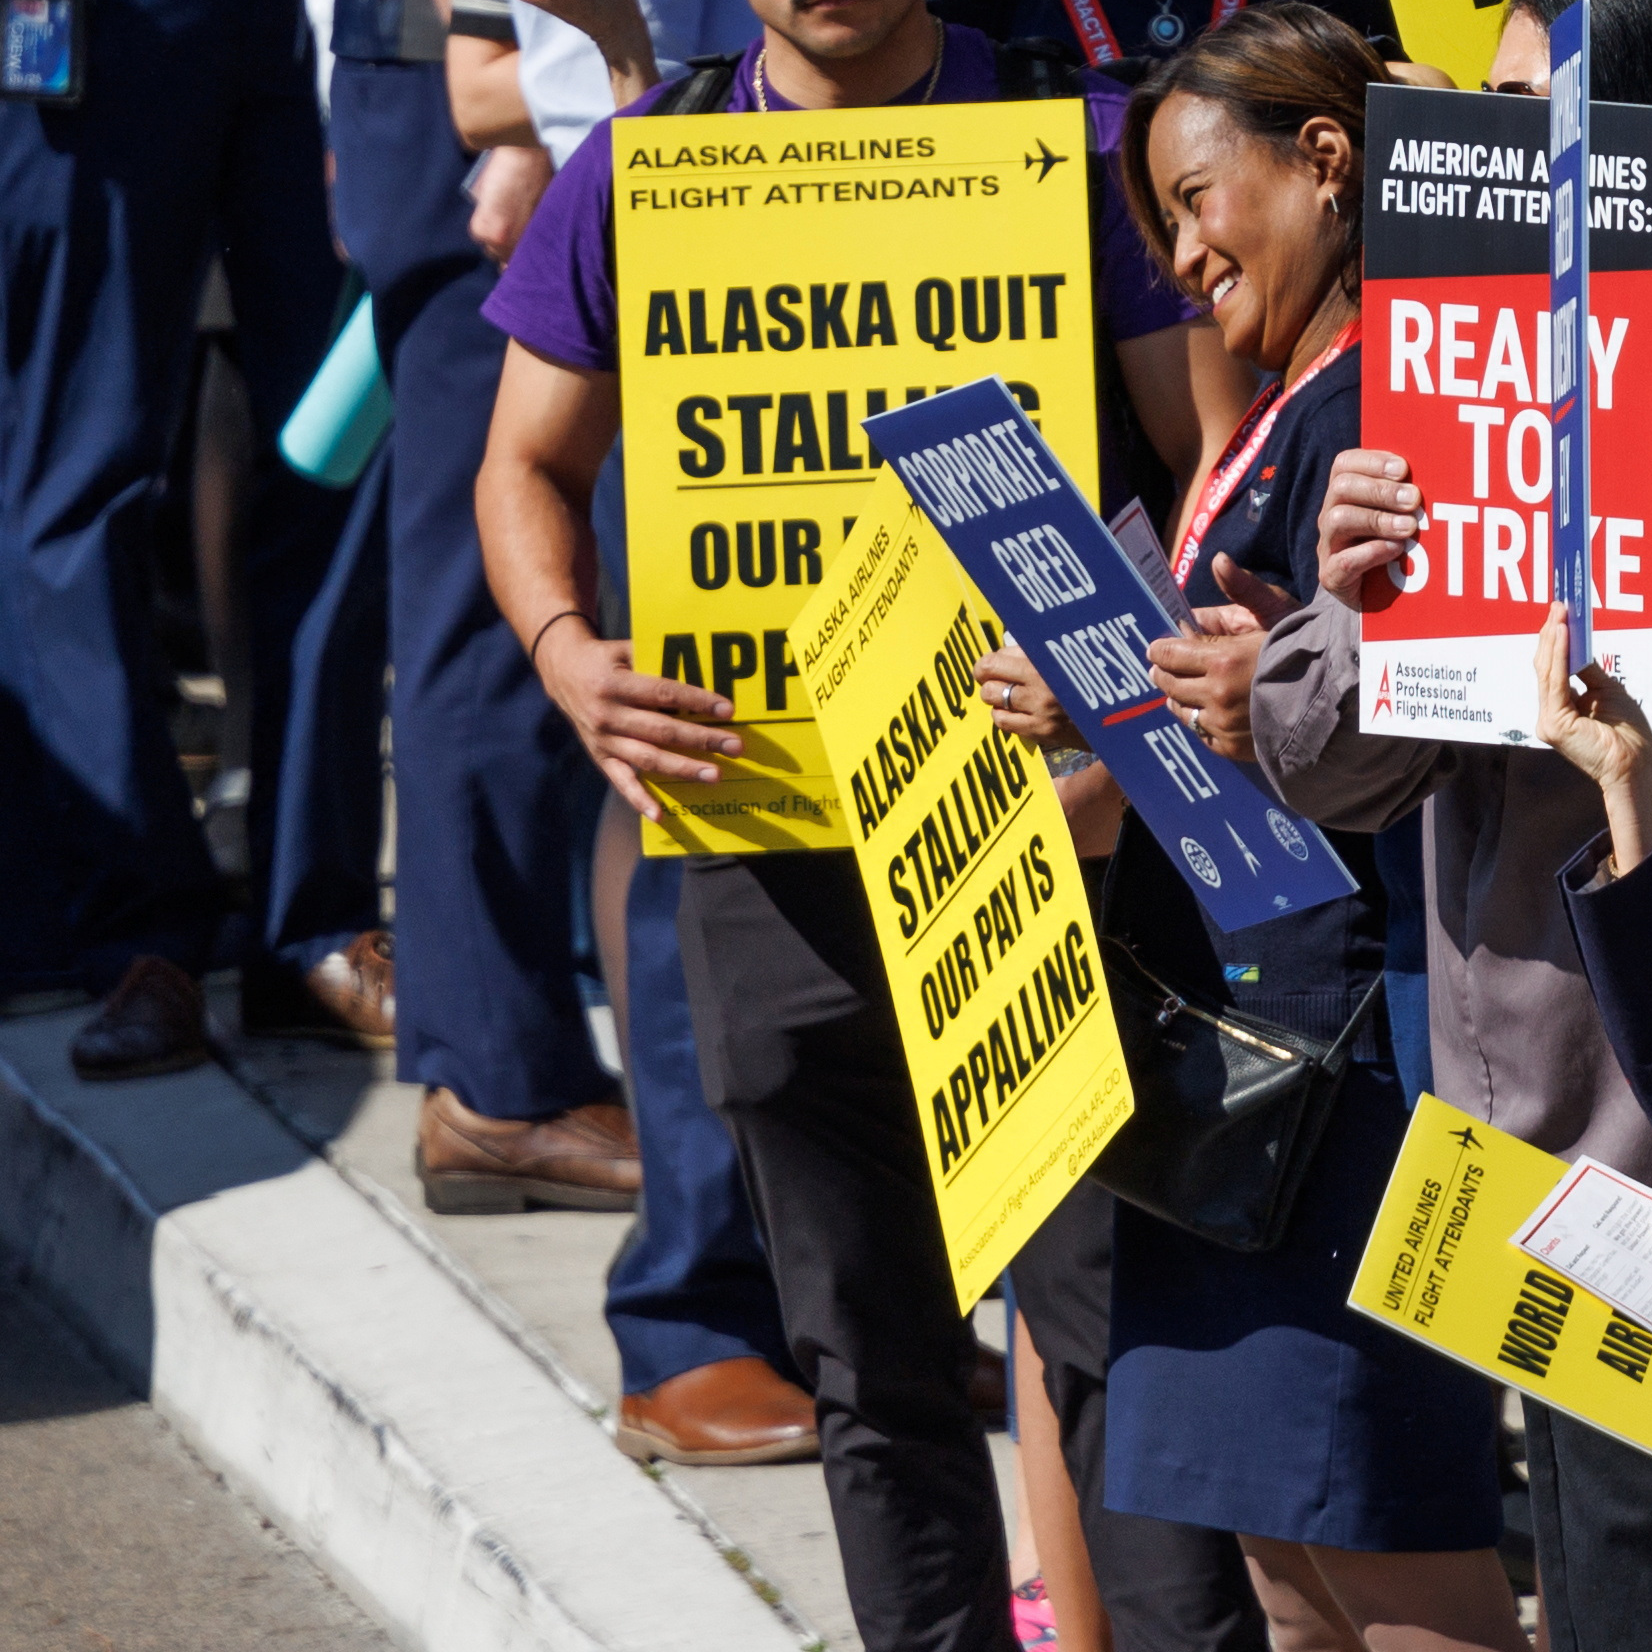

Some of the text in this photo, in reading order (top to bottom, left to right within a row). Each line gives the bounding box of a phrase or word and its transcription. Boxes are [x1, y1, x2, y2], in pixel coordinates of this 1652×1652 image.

[628, 137, 935, 169] ALASKA AIRLINES
[631, 176, 999, 210] FLIGHT ATTENDANTS
[1382, 179, 1470, 217] FLIGHT
[1389, 139, 1523, 181] AMERICAN
[645, 274, 1066, 356] ALASKA QUIT
[898, 419, 1061, 527] CORPORATE
[1458, 403, 1552, 504] TO
[689, 518, 821, 591] OUR
[805, 525, 890, 672] ALASKA AIRLINES
[991, 524, 1096, 612] GREED
[816, 536, 919, 709] FLIGHT ATTENDANTS
[1045, 612, 1158, 711] DOESN'T
[1602, 653, 1621, 674] WE
[1396, 662, 1477, 682] Association of
[1396, 682, 1466, 701] Professional
[1396, 701, 1492, 723] Flight Attendants
[851, 601, 984, 842] ALASKA QUIT
[1146, 723, 1220, 803] FLY
[888, 724, 1028, 940] STALLING
[921, 833, 1054, 1040] OUR PAY IS
[931, 920, 1094, 1178] APPALLING
[1382, 1179, 1442, 1312] UNITED AIRLINES
[1414, 1164, 1485, 1327] FLIGHT ATTENDANTS
[1497, 1269, 1574, 1378] WORLD
